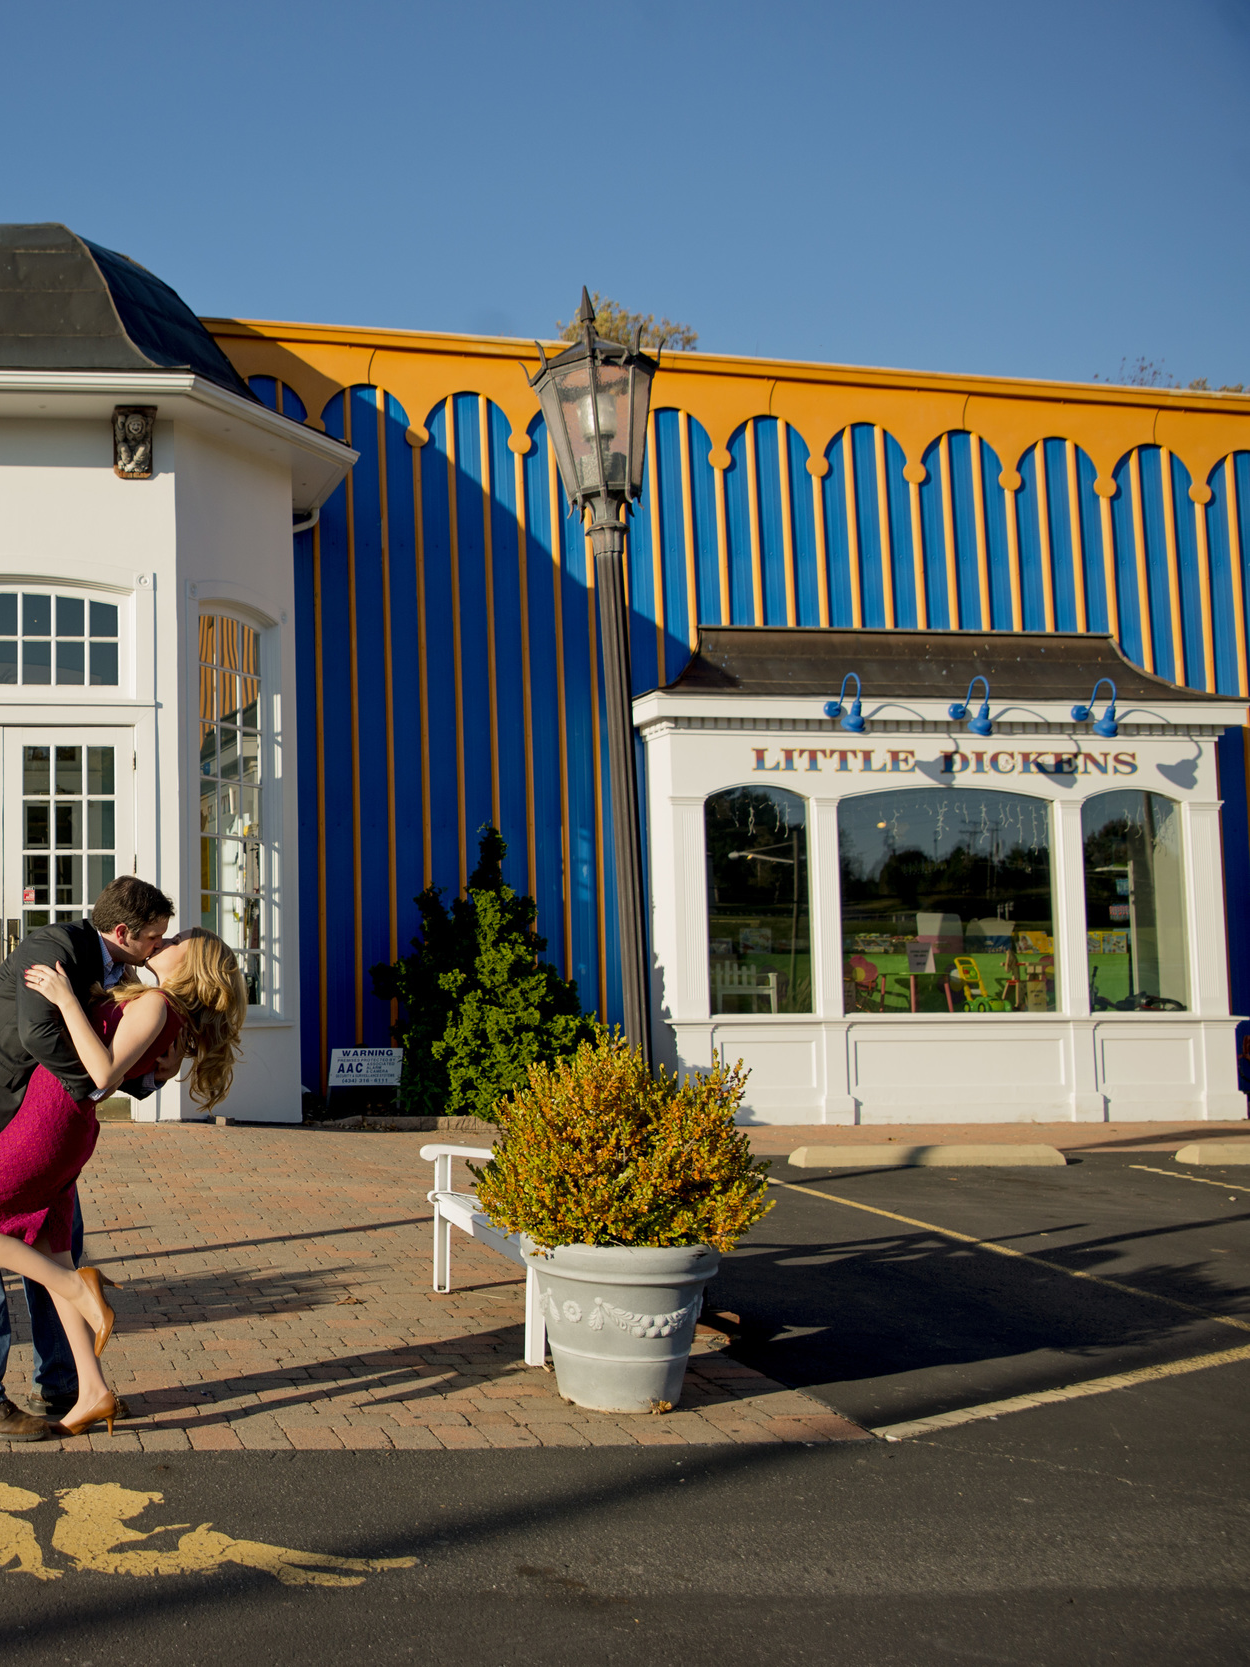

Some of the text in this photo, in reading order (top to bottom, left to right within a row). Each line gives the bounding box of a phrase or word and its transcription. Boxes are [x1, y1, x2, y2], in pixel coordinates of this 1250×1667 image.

[752, 748, 1138, 775] LITTLE DICKENS
[337, 1062, 363, 1073] AAC
